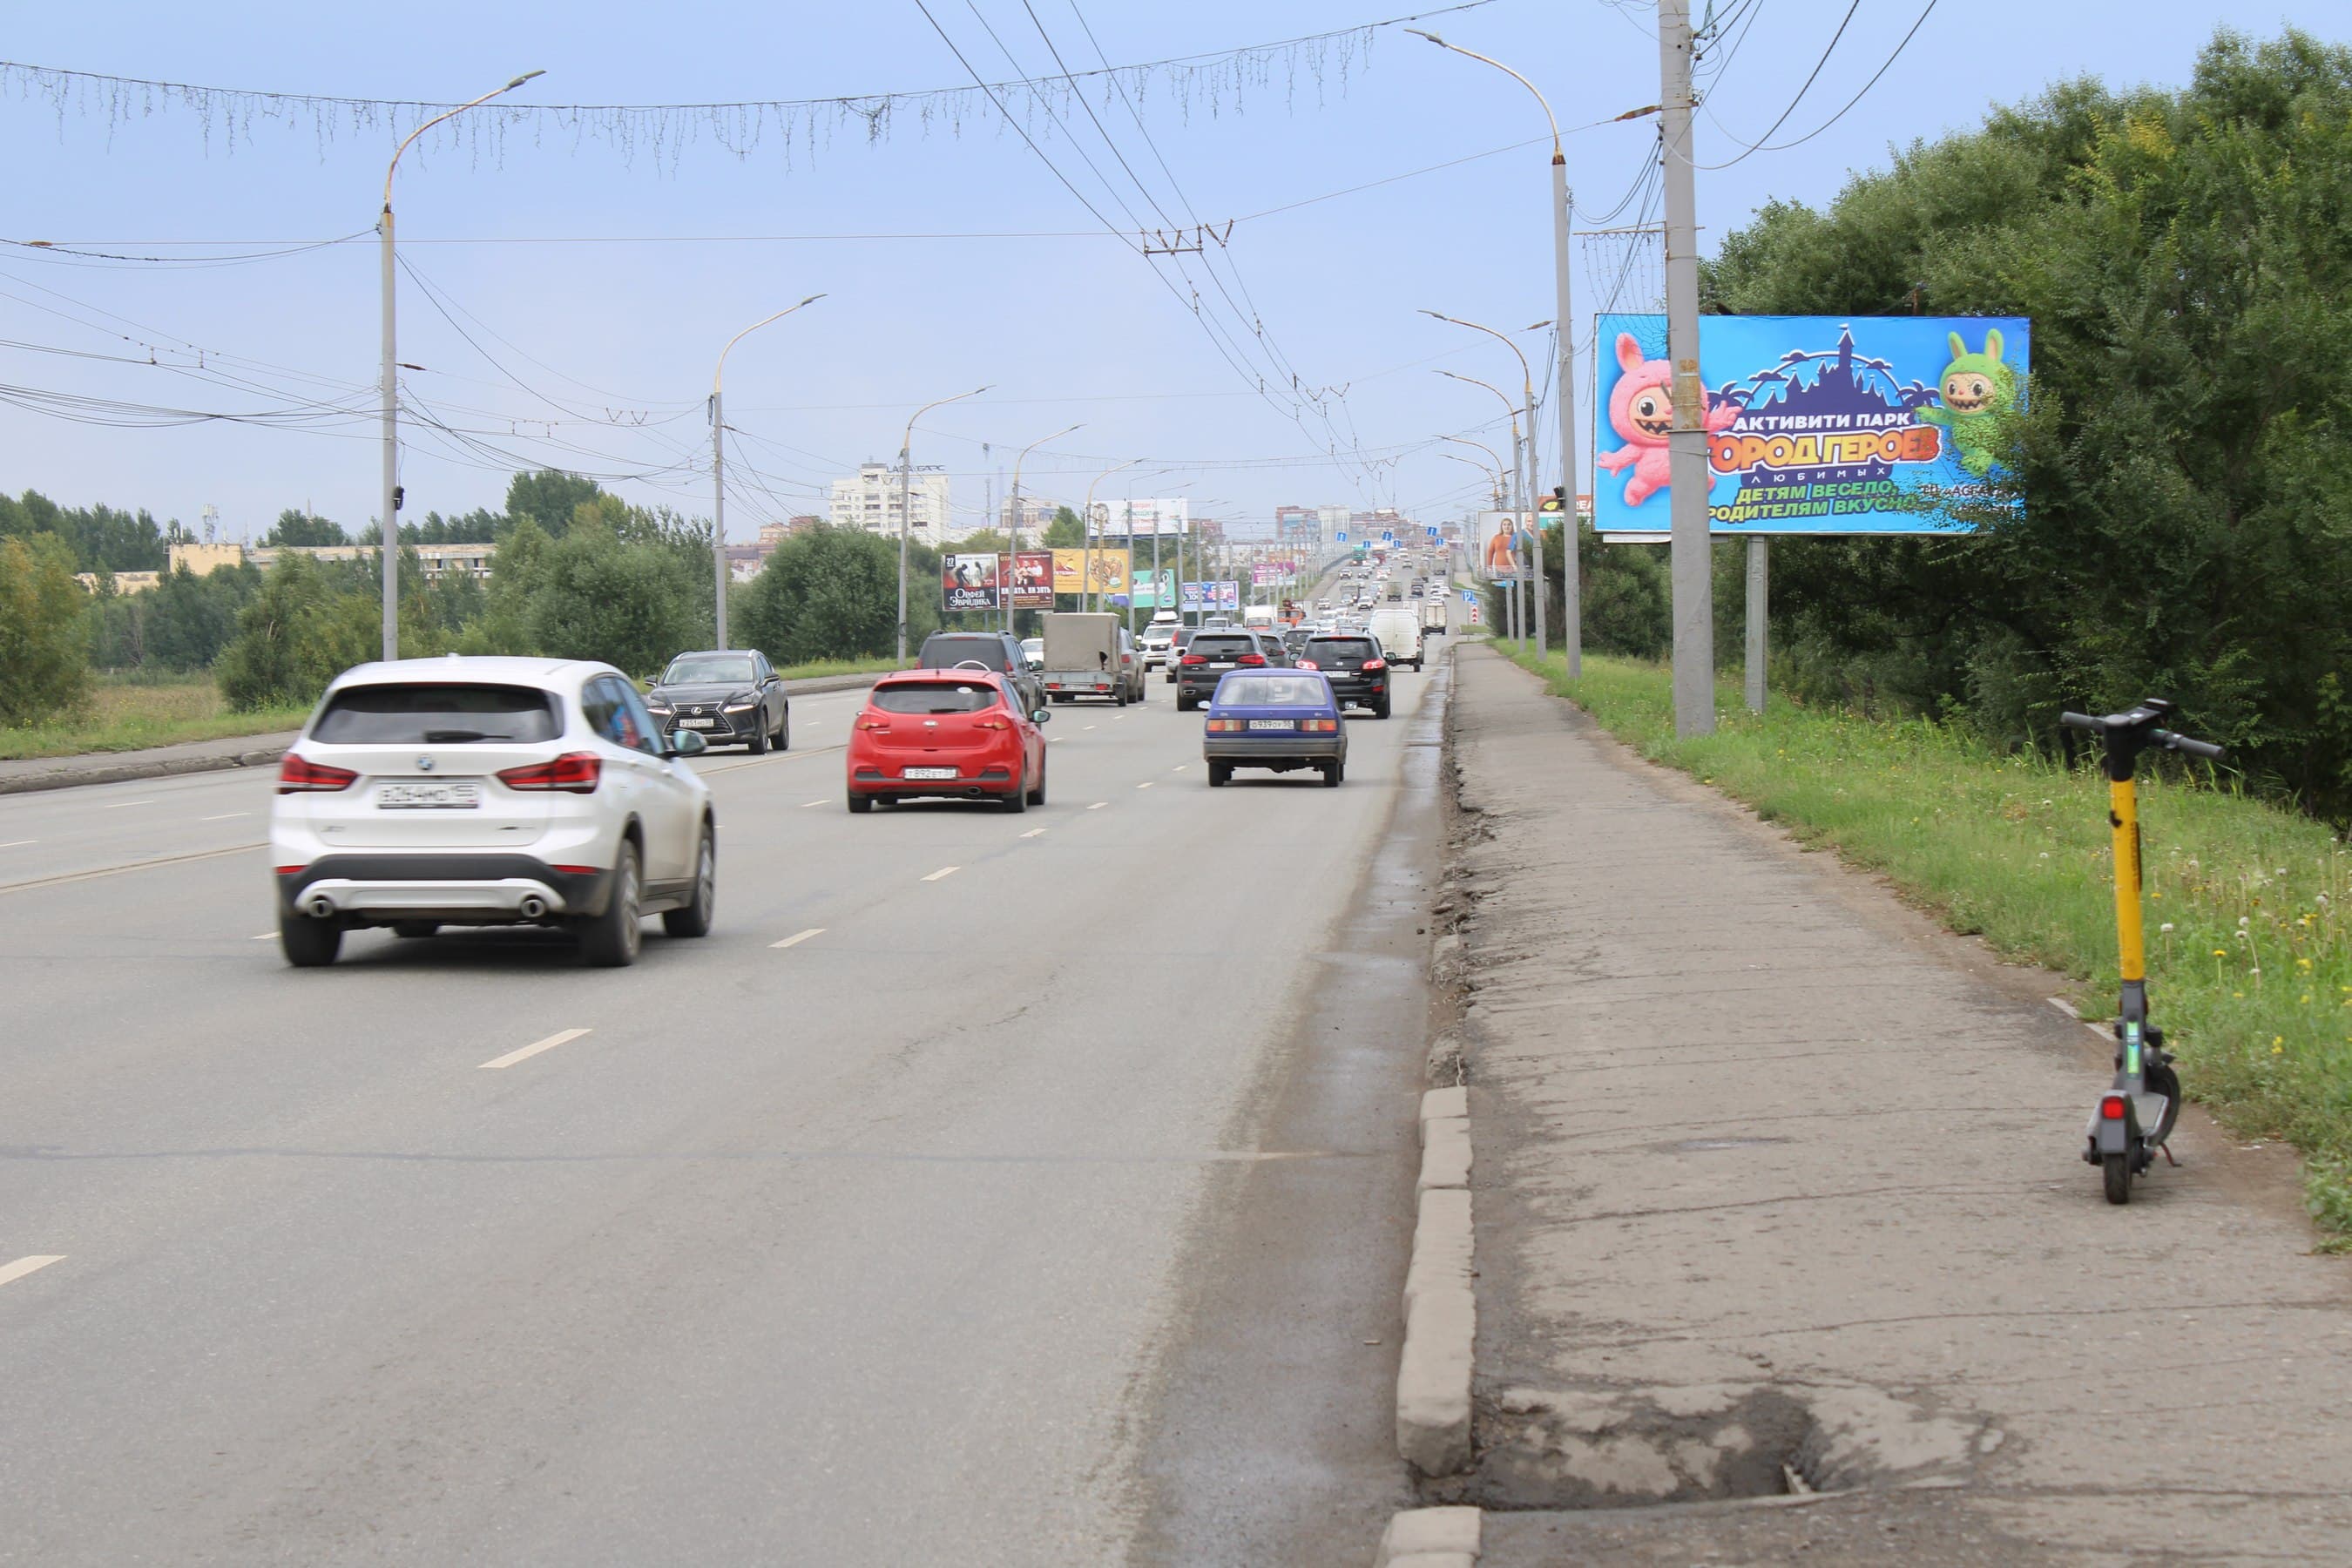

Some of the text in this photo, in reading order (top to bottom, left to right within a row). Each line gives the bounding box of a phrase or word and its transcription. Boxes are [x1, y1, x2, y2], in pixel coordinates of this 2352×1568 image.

[1733, 412, 1910, 431] АКТИВИТИ ПАРК
[1708, 425, 1939, 472] ОРОД ГЕРОЕВ
[1751, 468, 1885, 483] ЛЮБИМЫХ
[1735, 485, 1807, 505] ДЕТЯМ
